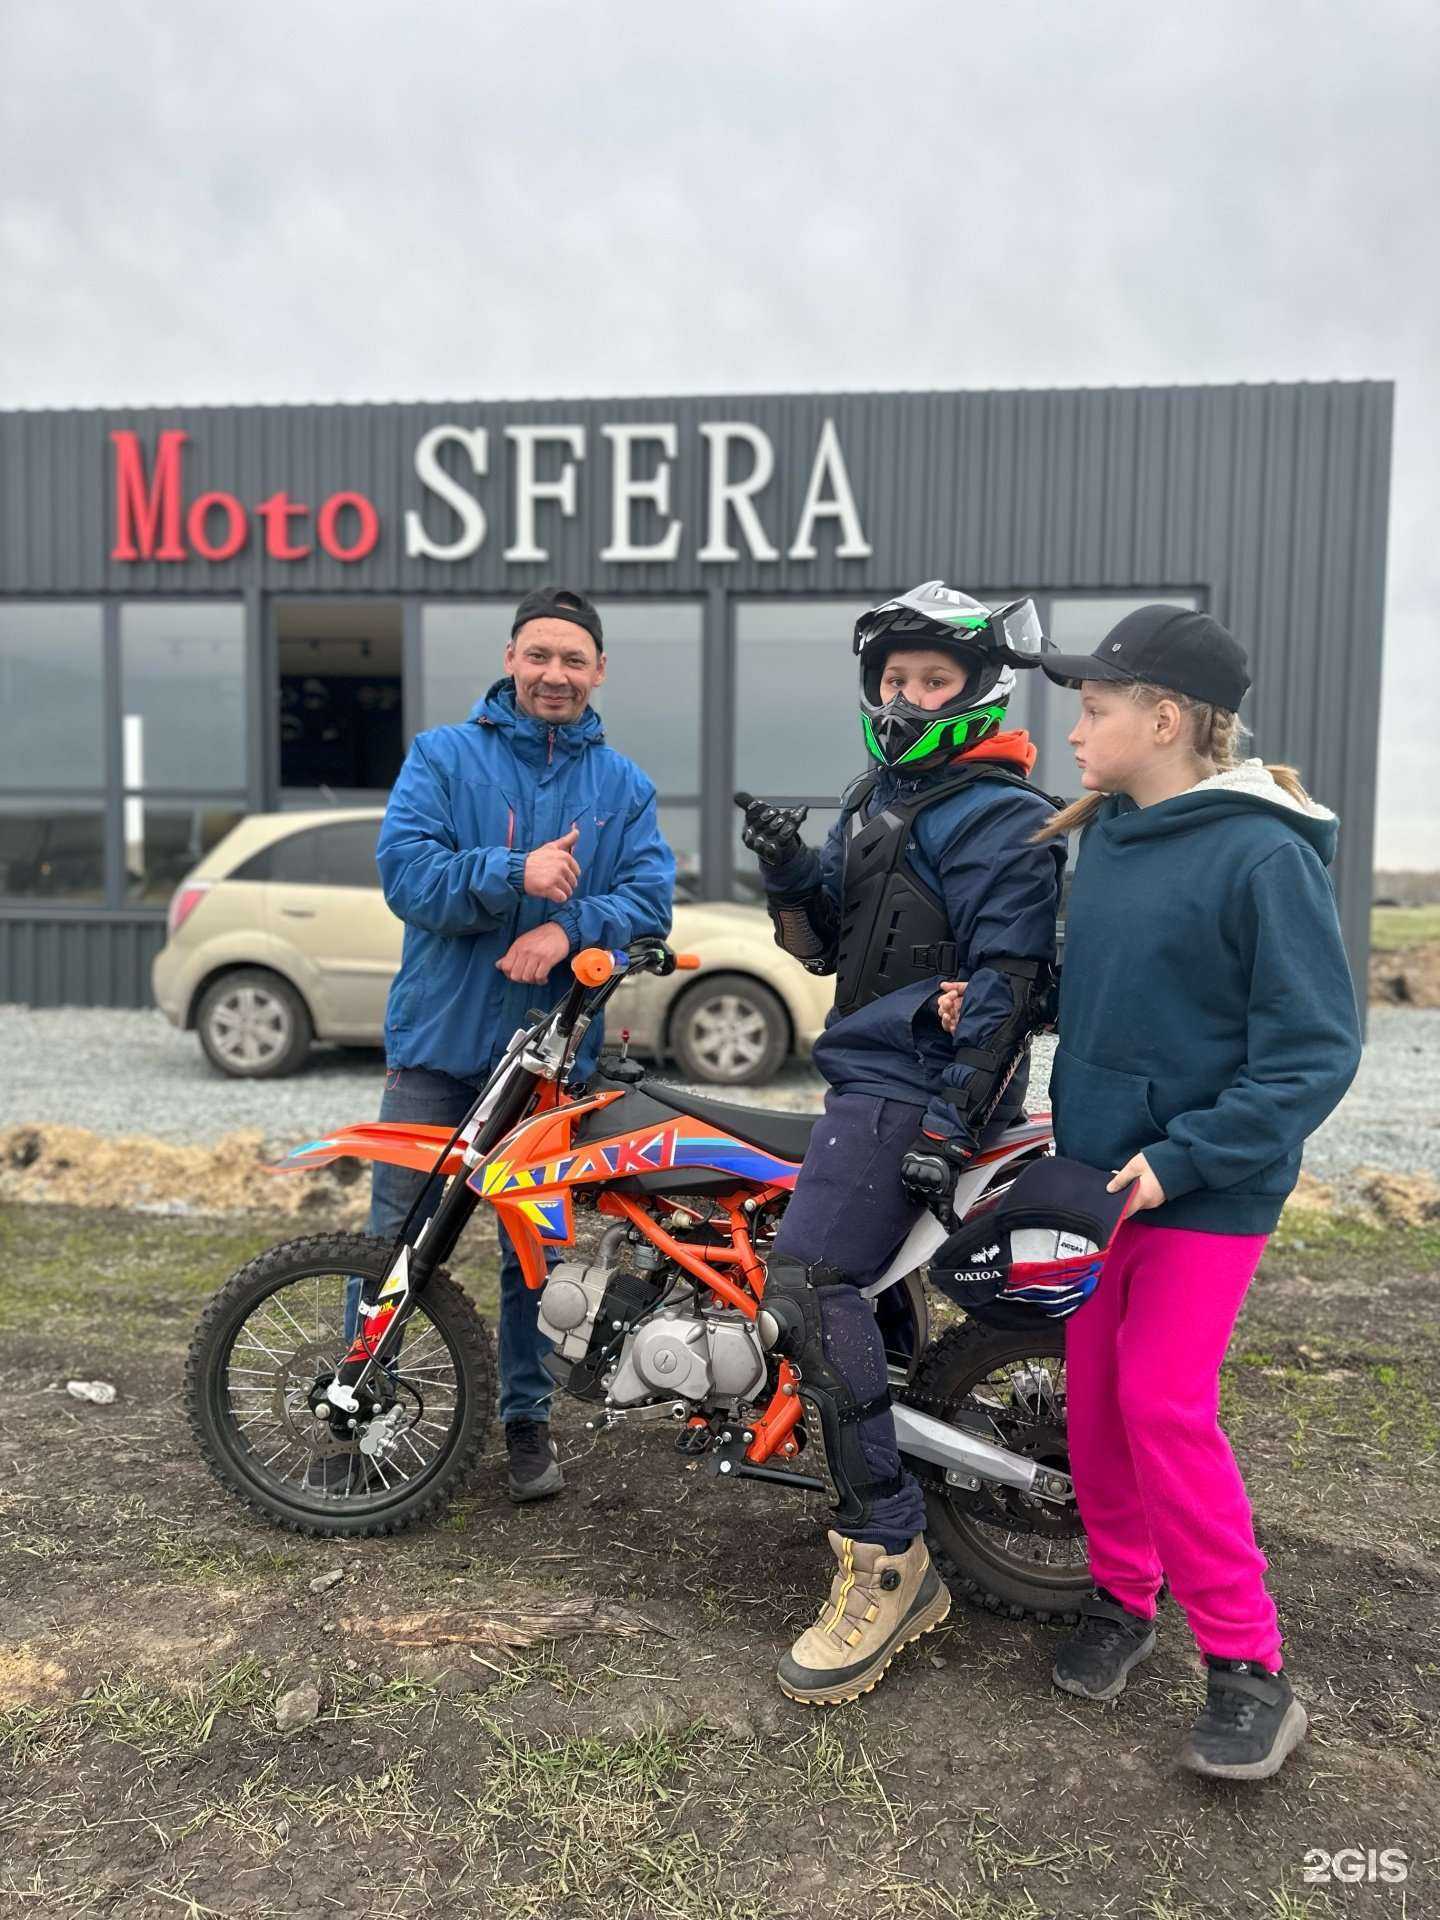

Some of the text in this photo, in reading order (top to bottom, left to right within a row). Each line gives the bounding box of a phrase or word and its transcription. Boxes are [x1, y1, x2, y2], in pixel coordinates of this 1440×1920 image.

[111, 418, 872, 562] Moto SFERA
[954, 1270, 1003, 1282] VOLVO
